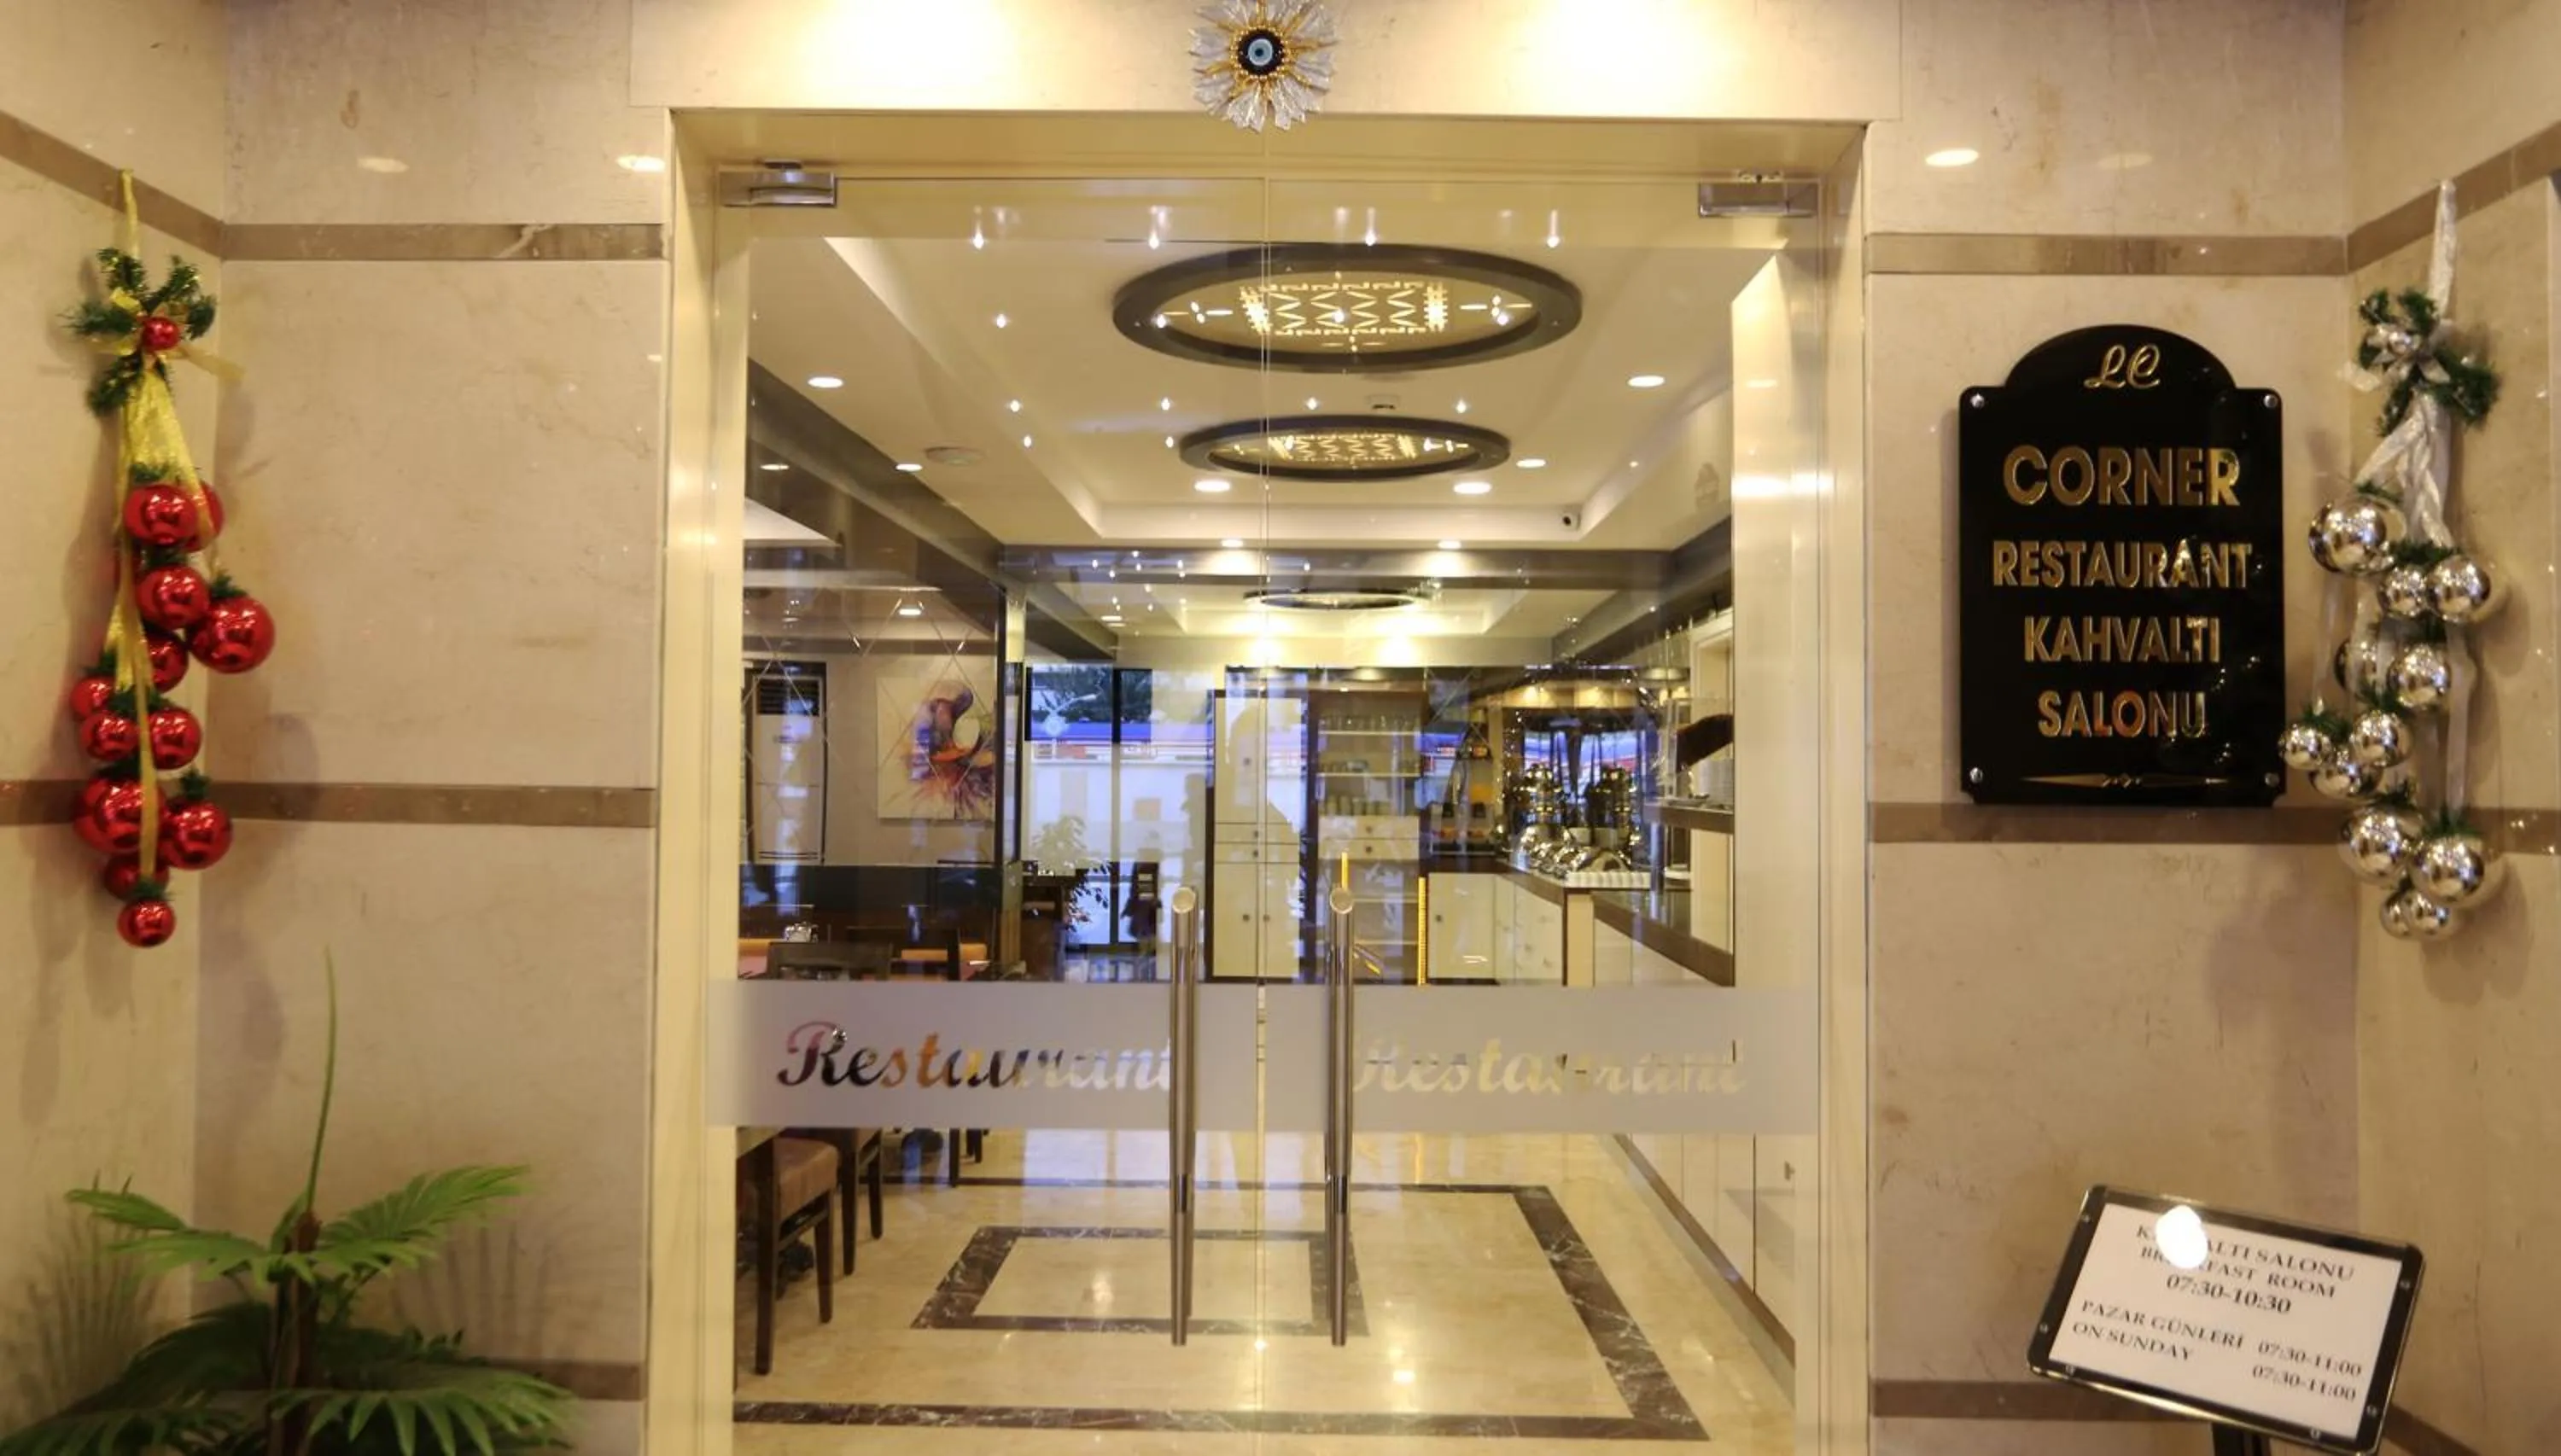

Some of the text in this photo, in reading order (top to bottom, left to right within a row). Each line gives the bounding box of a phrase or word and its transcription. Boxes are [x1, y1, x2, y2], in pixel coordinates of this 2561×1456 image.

[2003, 445, 2240, 506] CORNER
[1992, 539, 2252, 588] RESTAURANT
[2024, 616, 2220, 663] KAHVALTI
[2039, 690, 2207, 737] SALONU
[2136, 1225, 2354, 1282] KALTI SALONU
[2166, 1273, 2292, 1313] 07:30-10:30
[2266, 1273, 2336, 1299] ROOM
[2073, 1322, 2356, 1401] ON SUNDAY 07:30-11:00
[2082, 1300, 2145, 1325] PAZAR
[2258, 1341, 2362, 1377] 07:30-11:00
